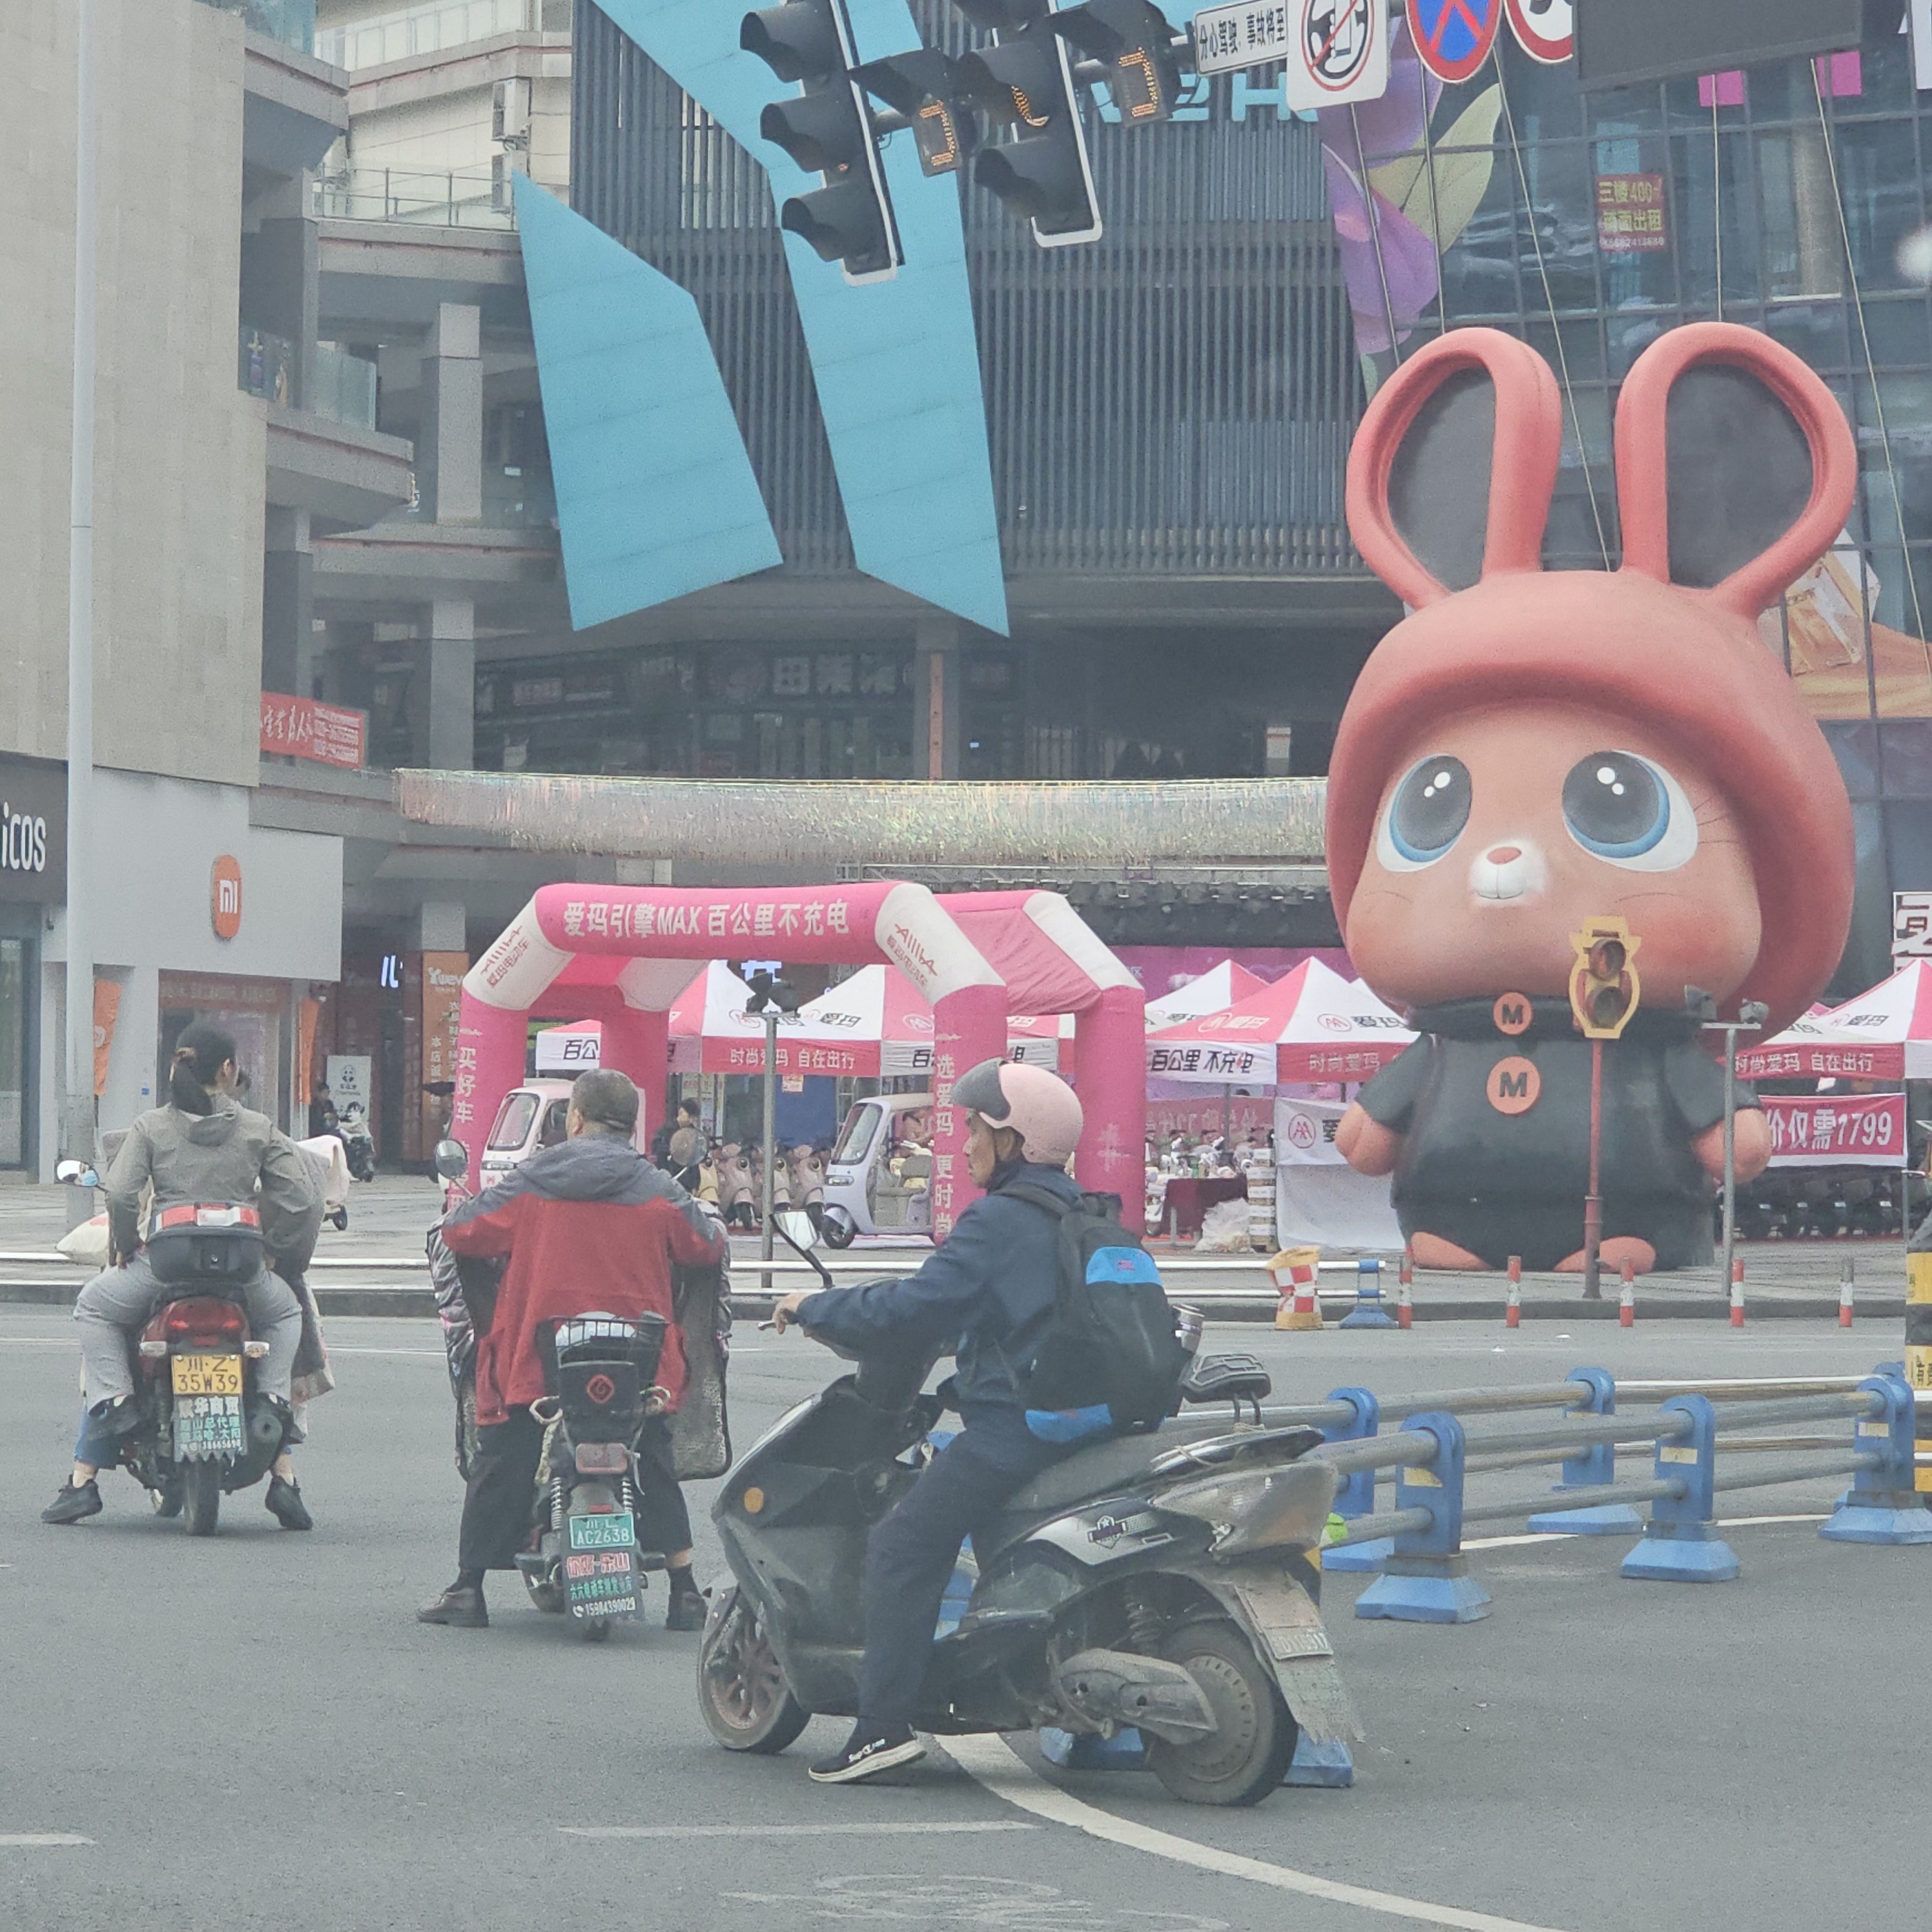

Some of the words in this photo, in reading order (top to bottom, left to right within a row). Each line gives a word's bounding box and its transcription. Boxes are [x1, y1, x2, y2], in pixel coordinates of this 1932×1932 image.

[2, 801, 46, 872] icos
[1502, 1003, 1524, 1025] M
[798, 1049, 855, 1070] 自在出行
[1811, 1052, 1874, 1072] 自在出行
[1499, 1072, 1528, 1098] M
[577, 1527, 630, 1545] AC2638
